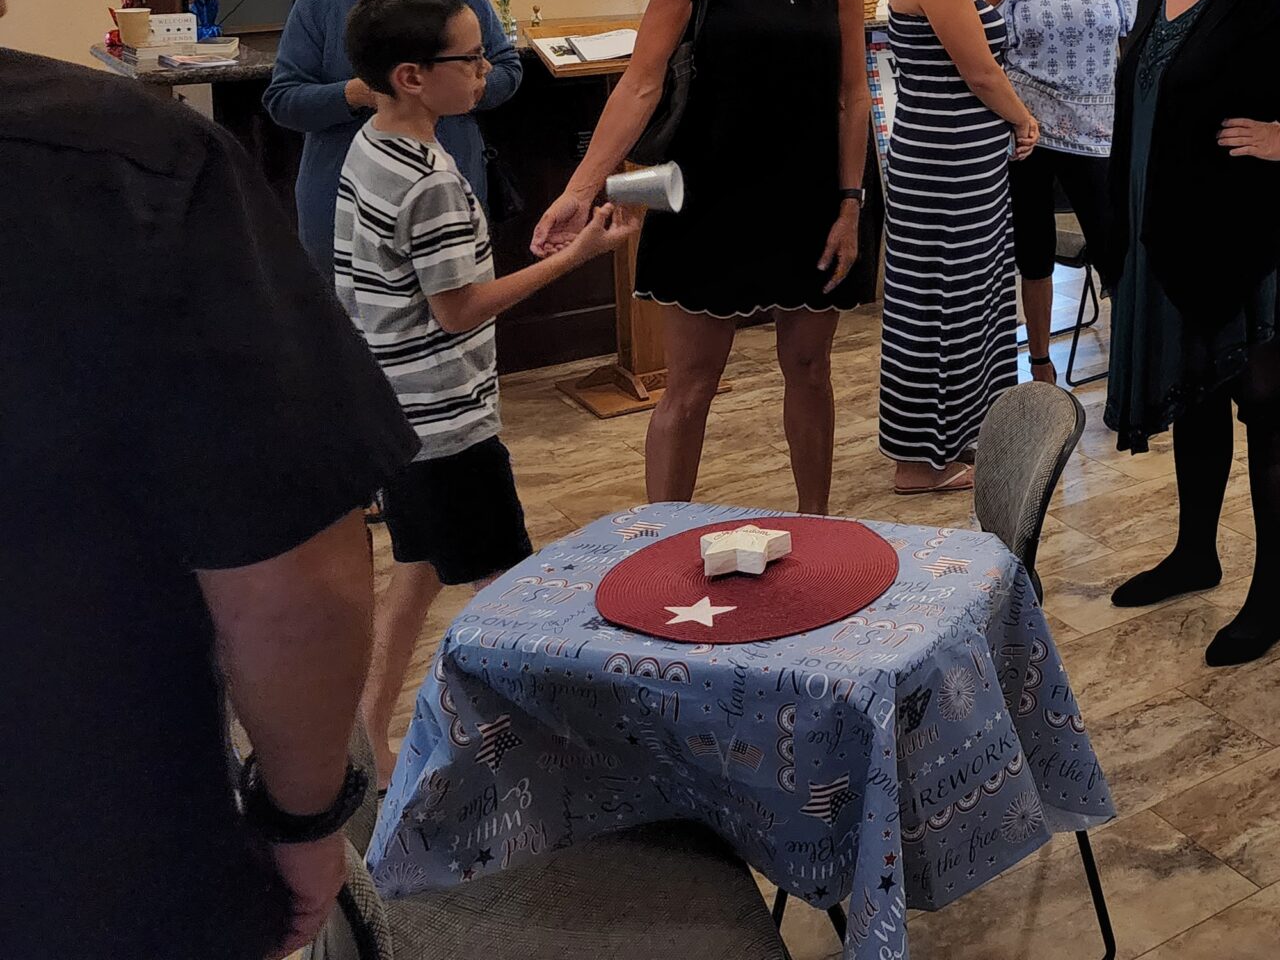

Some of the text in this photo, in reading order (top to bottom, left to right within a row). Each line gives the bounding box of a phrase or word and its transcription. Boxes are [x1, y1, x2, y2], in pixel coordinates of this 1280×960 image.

[454, 625, 590, 660] FREEDO
[896, 722, 941, 761] HAPP
[500, 777, 533, 809] &
[447, 809, 522, 852] WHITE
[500, 820, 548, 870] Red
[785, 837, 835, 864] Blue
